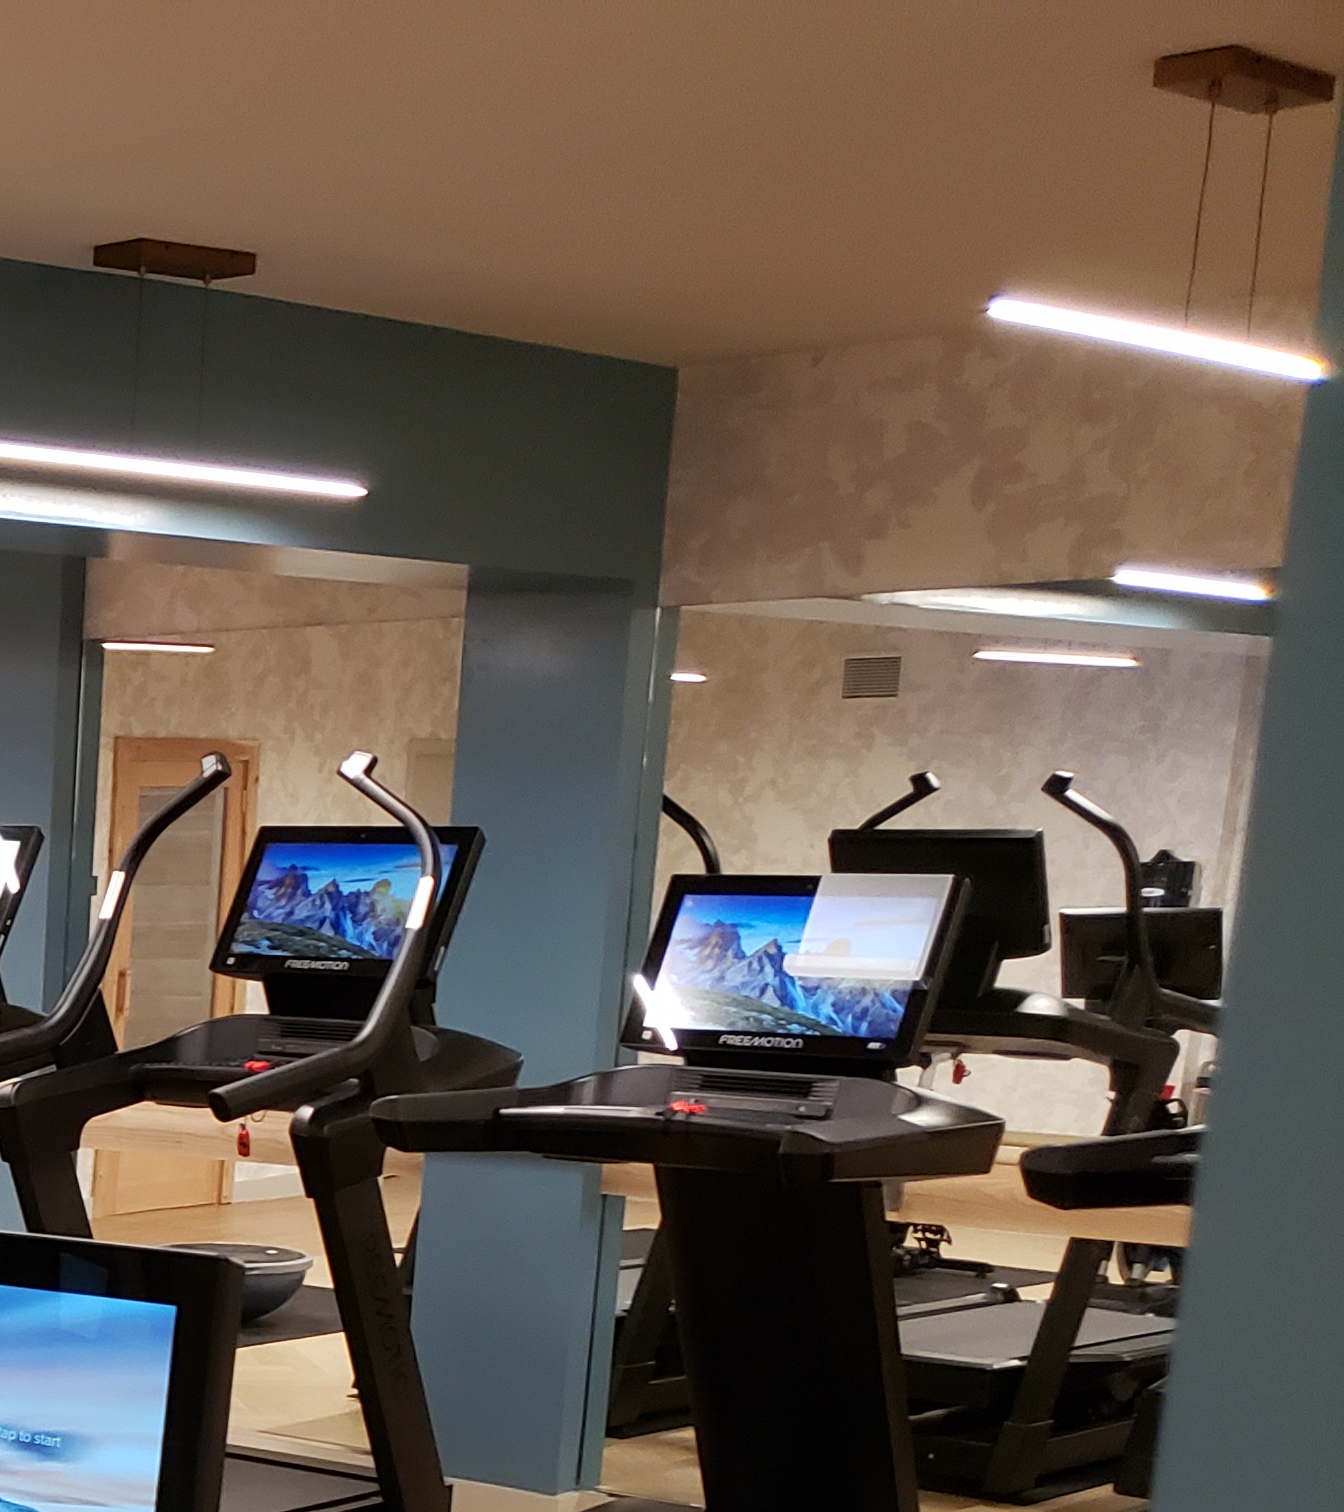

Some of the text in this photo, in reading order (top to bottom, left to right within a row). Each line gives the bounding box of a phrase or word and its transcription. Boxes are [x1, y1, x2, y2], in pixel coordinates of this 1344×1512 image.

[718, 1034, 804, 1049] FREEMOTION
[18, 1431, 32, 1443] to
[33, 1434, 62, 1448] start
